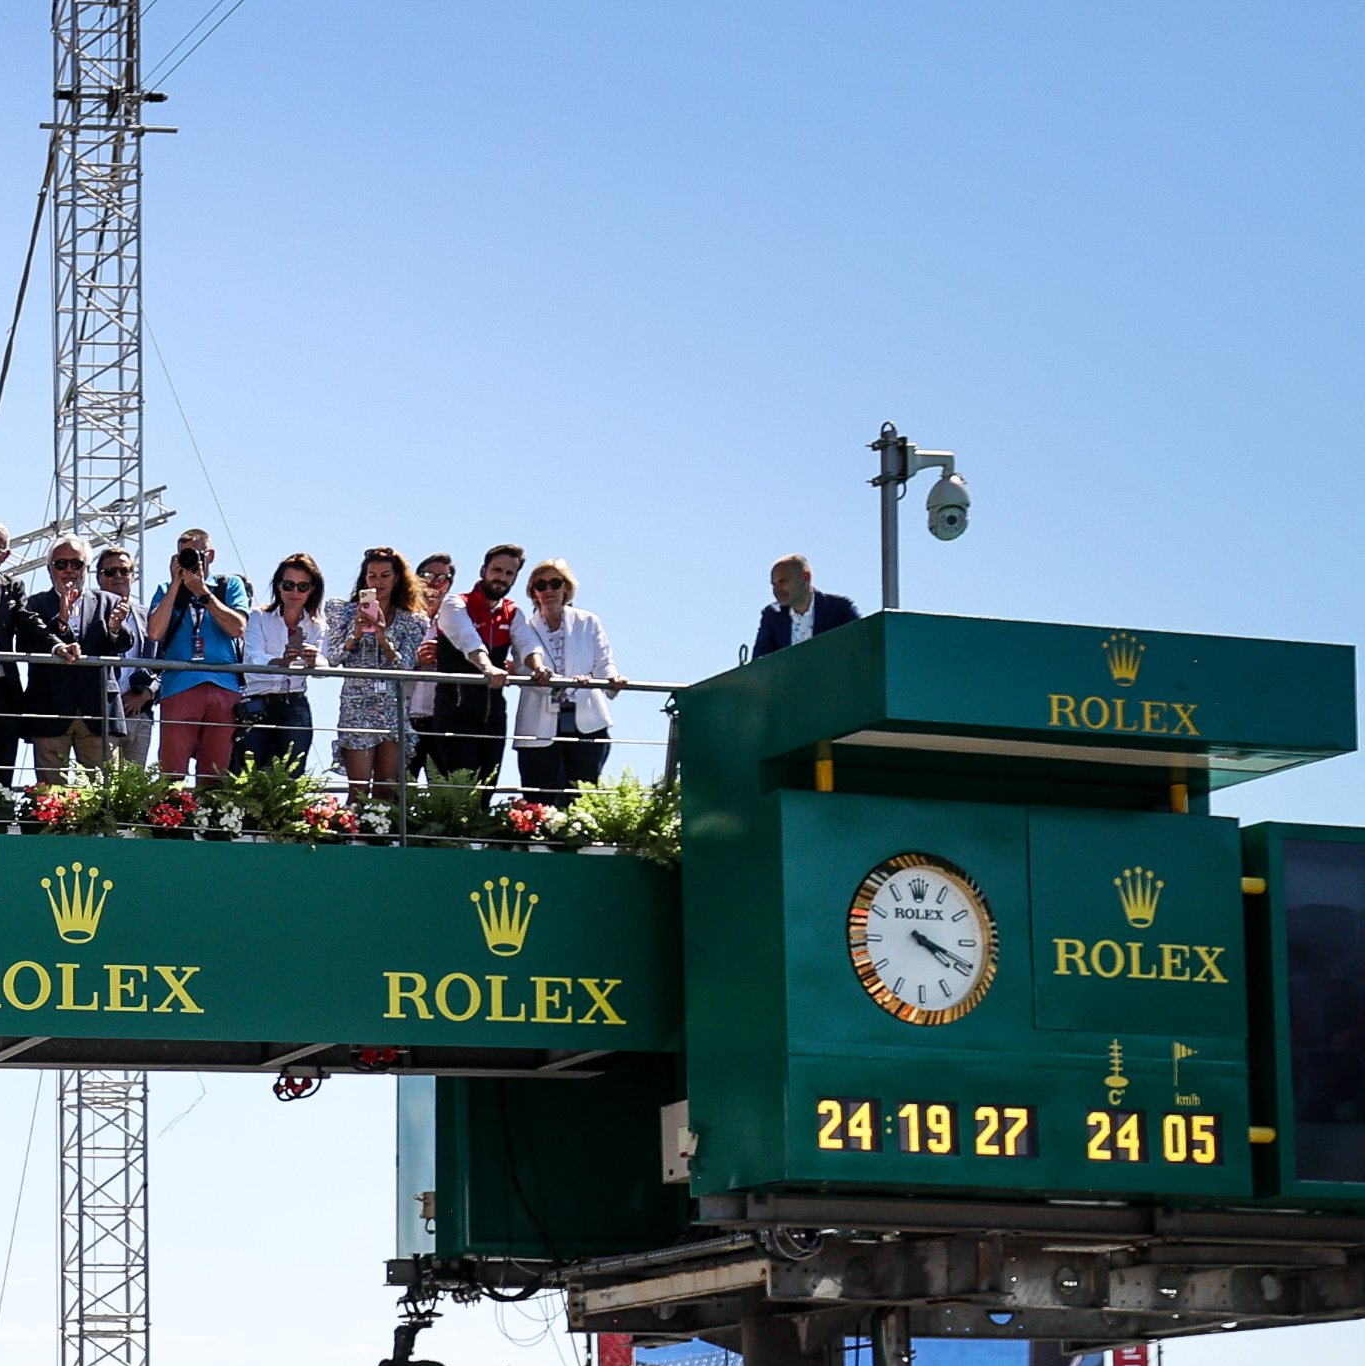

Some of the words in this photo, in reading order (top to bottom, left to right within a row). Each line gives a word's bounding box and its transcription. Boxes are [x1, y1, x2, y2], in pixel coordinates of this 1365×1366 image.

[1048, 695, 1202, 737] ROLEX
[895, 907, 943, 921] ROLEX
[1052, 938, 1229, 984] ROLEX
[384, 971, 627, 1026] ROLEX
[1087, 1111, 1140, 1162] 24
[1163, 1114, 1215, 1164] 05
